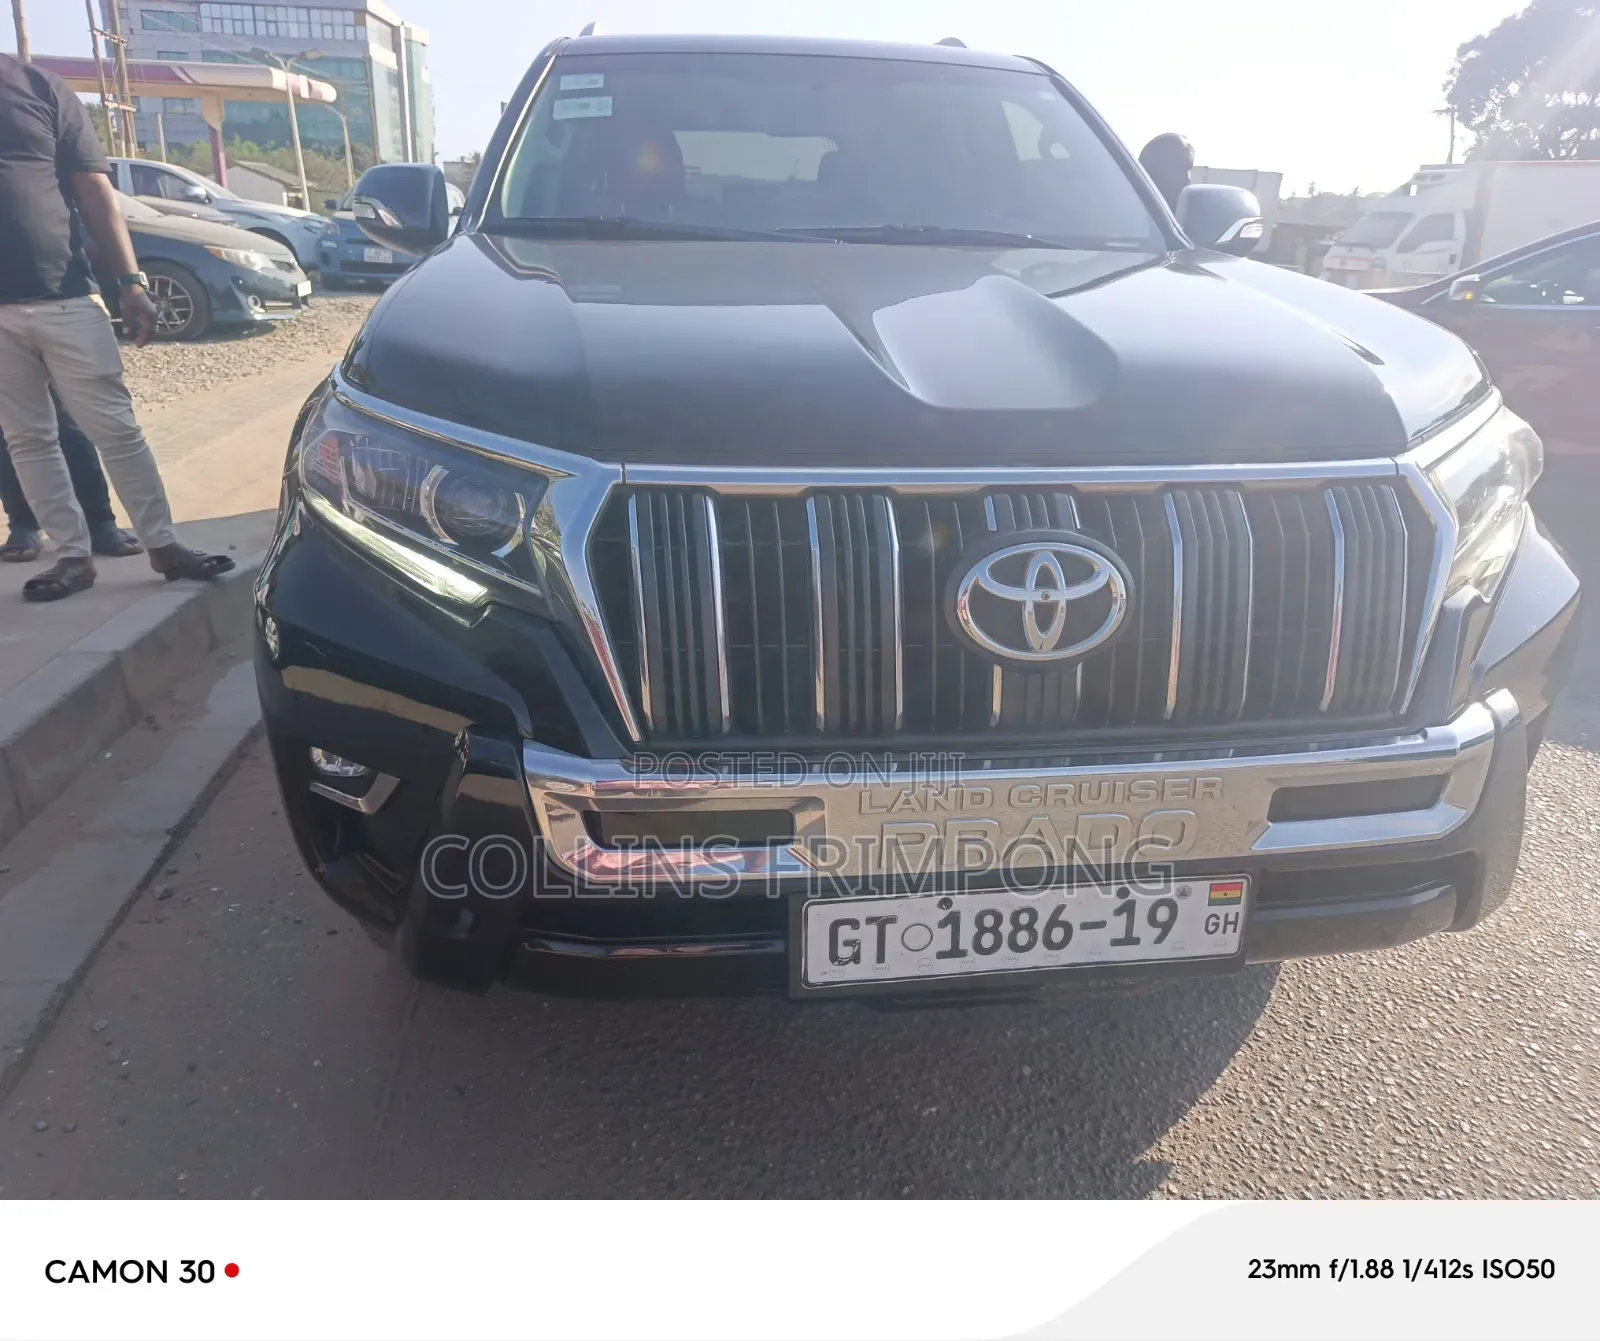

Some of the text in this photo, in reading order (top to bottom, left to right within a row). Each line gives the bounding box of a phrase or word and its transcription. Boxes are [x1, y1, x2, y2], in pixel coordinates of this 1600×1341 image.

[858, 776, 1225, 816] LAND CRUISER
[876, 809, 1200, 869] PRADO
[828, 897, 1179, 966] GT 1886-19
[1204, 911, 1240, 936] GH
